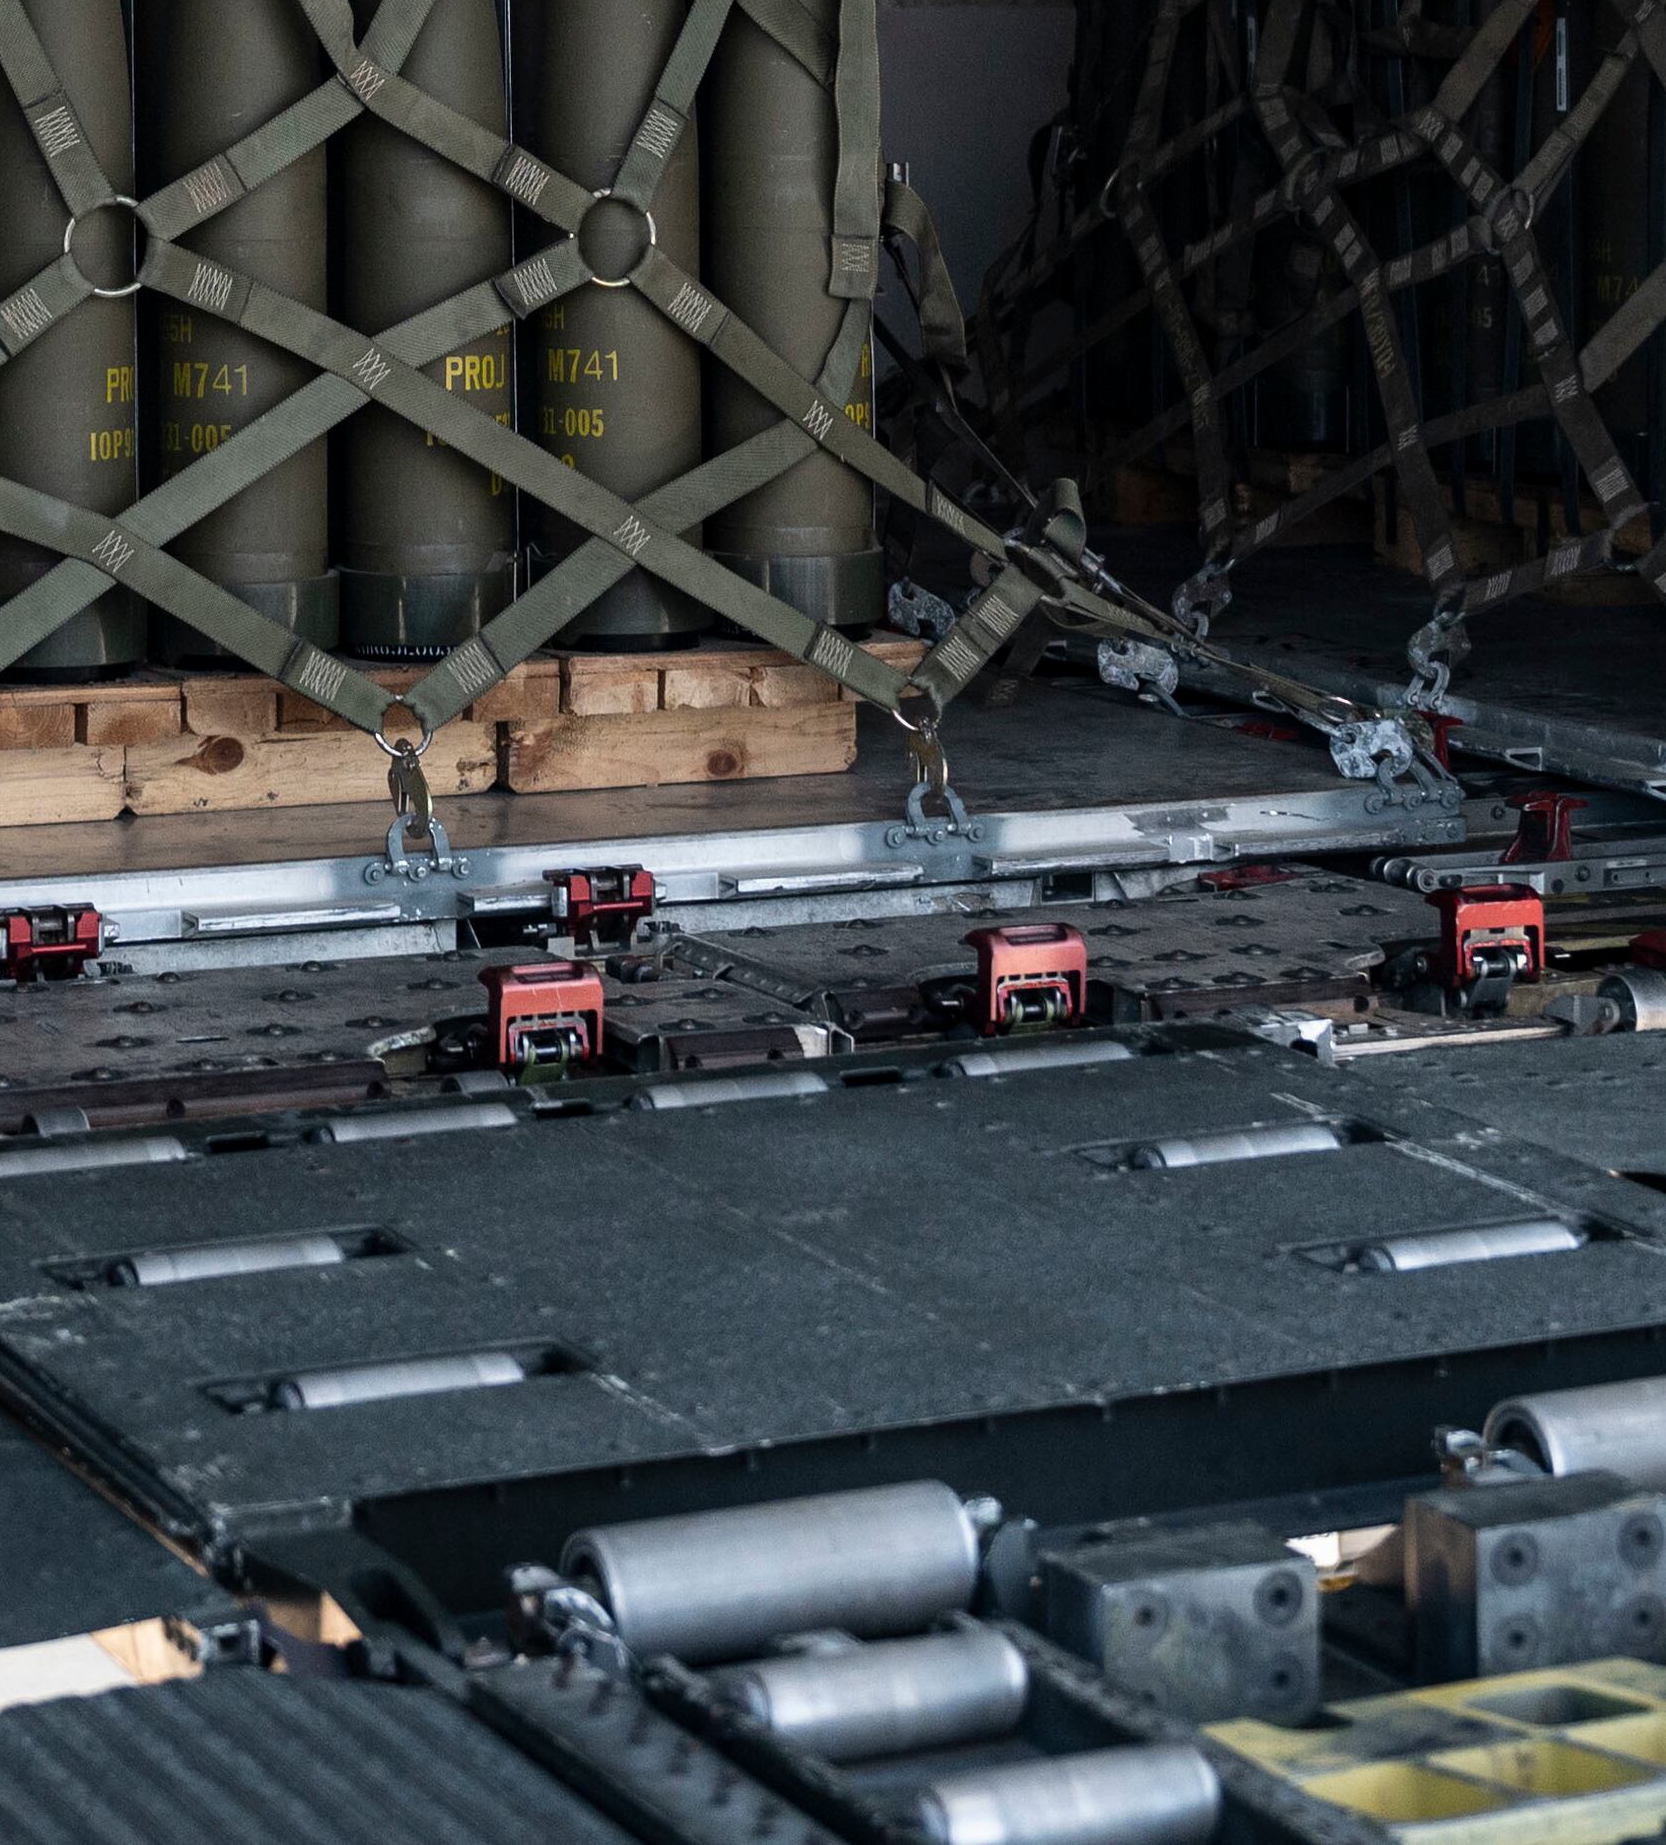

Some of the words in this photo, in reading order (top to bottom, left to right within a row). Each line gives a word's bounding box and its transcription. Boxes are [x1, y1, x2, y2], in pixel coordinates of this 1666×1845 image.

[173, 362, 249, 400] M741
[444, 354, 507, 392] PROJ
[547, 349, 619, 385] M741
